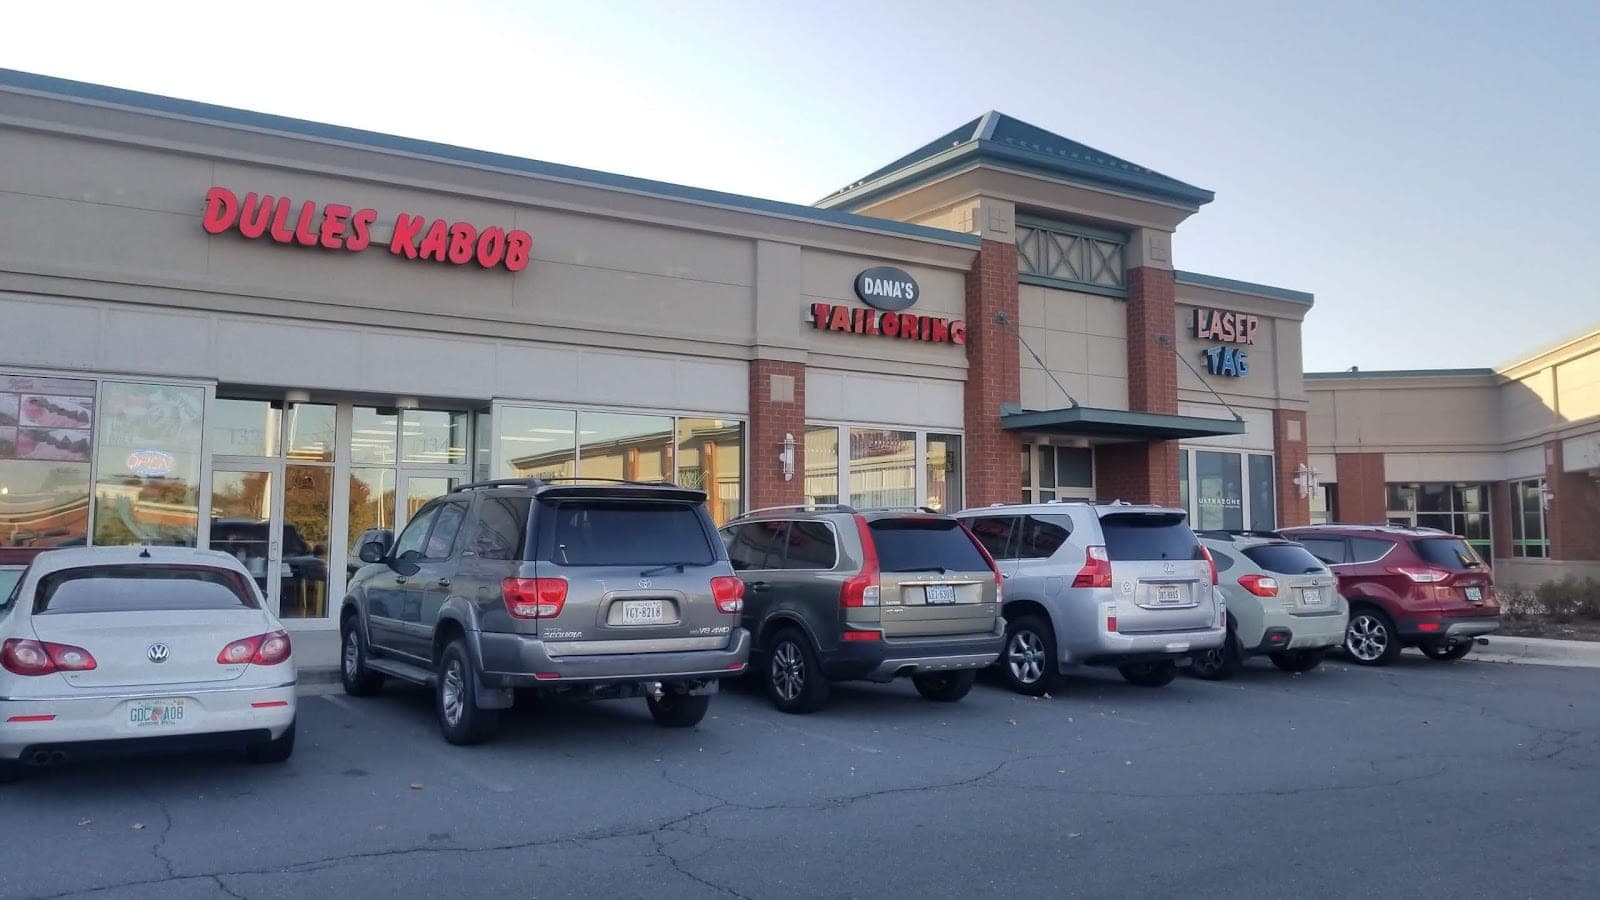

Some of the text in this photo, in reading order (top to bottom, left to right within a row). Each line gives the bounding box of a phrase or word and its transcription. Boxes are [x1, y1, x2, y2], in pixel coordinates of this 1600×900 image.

[203, 187, 534, 272] DULLES KABOB
[864, 277, 914, 299] DANA'S
[811, 303, 966, 345] TAILORING
[1194, 308, 1258, 345] LASER
[1205, 345, 1249, 378] TAG
